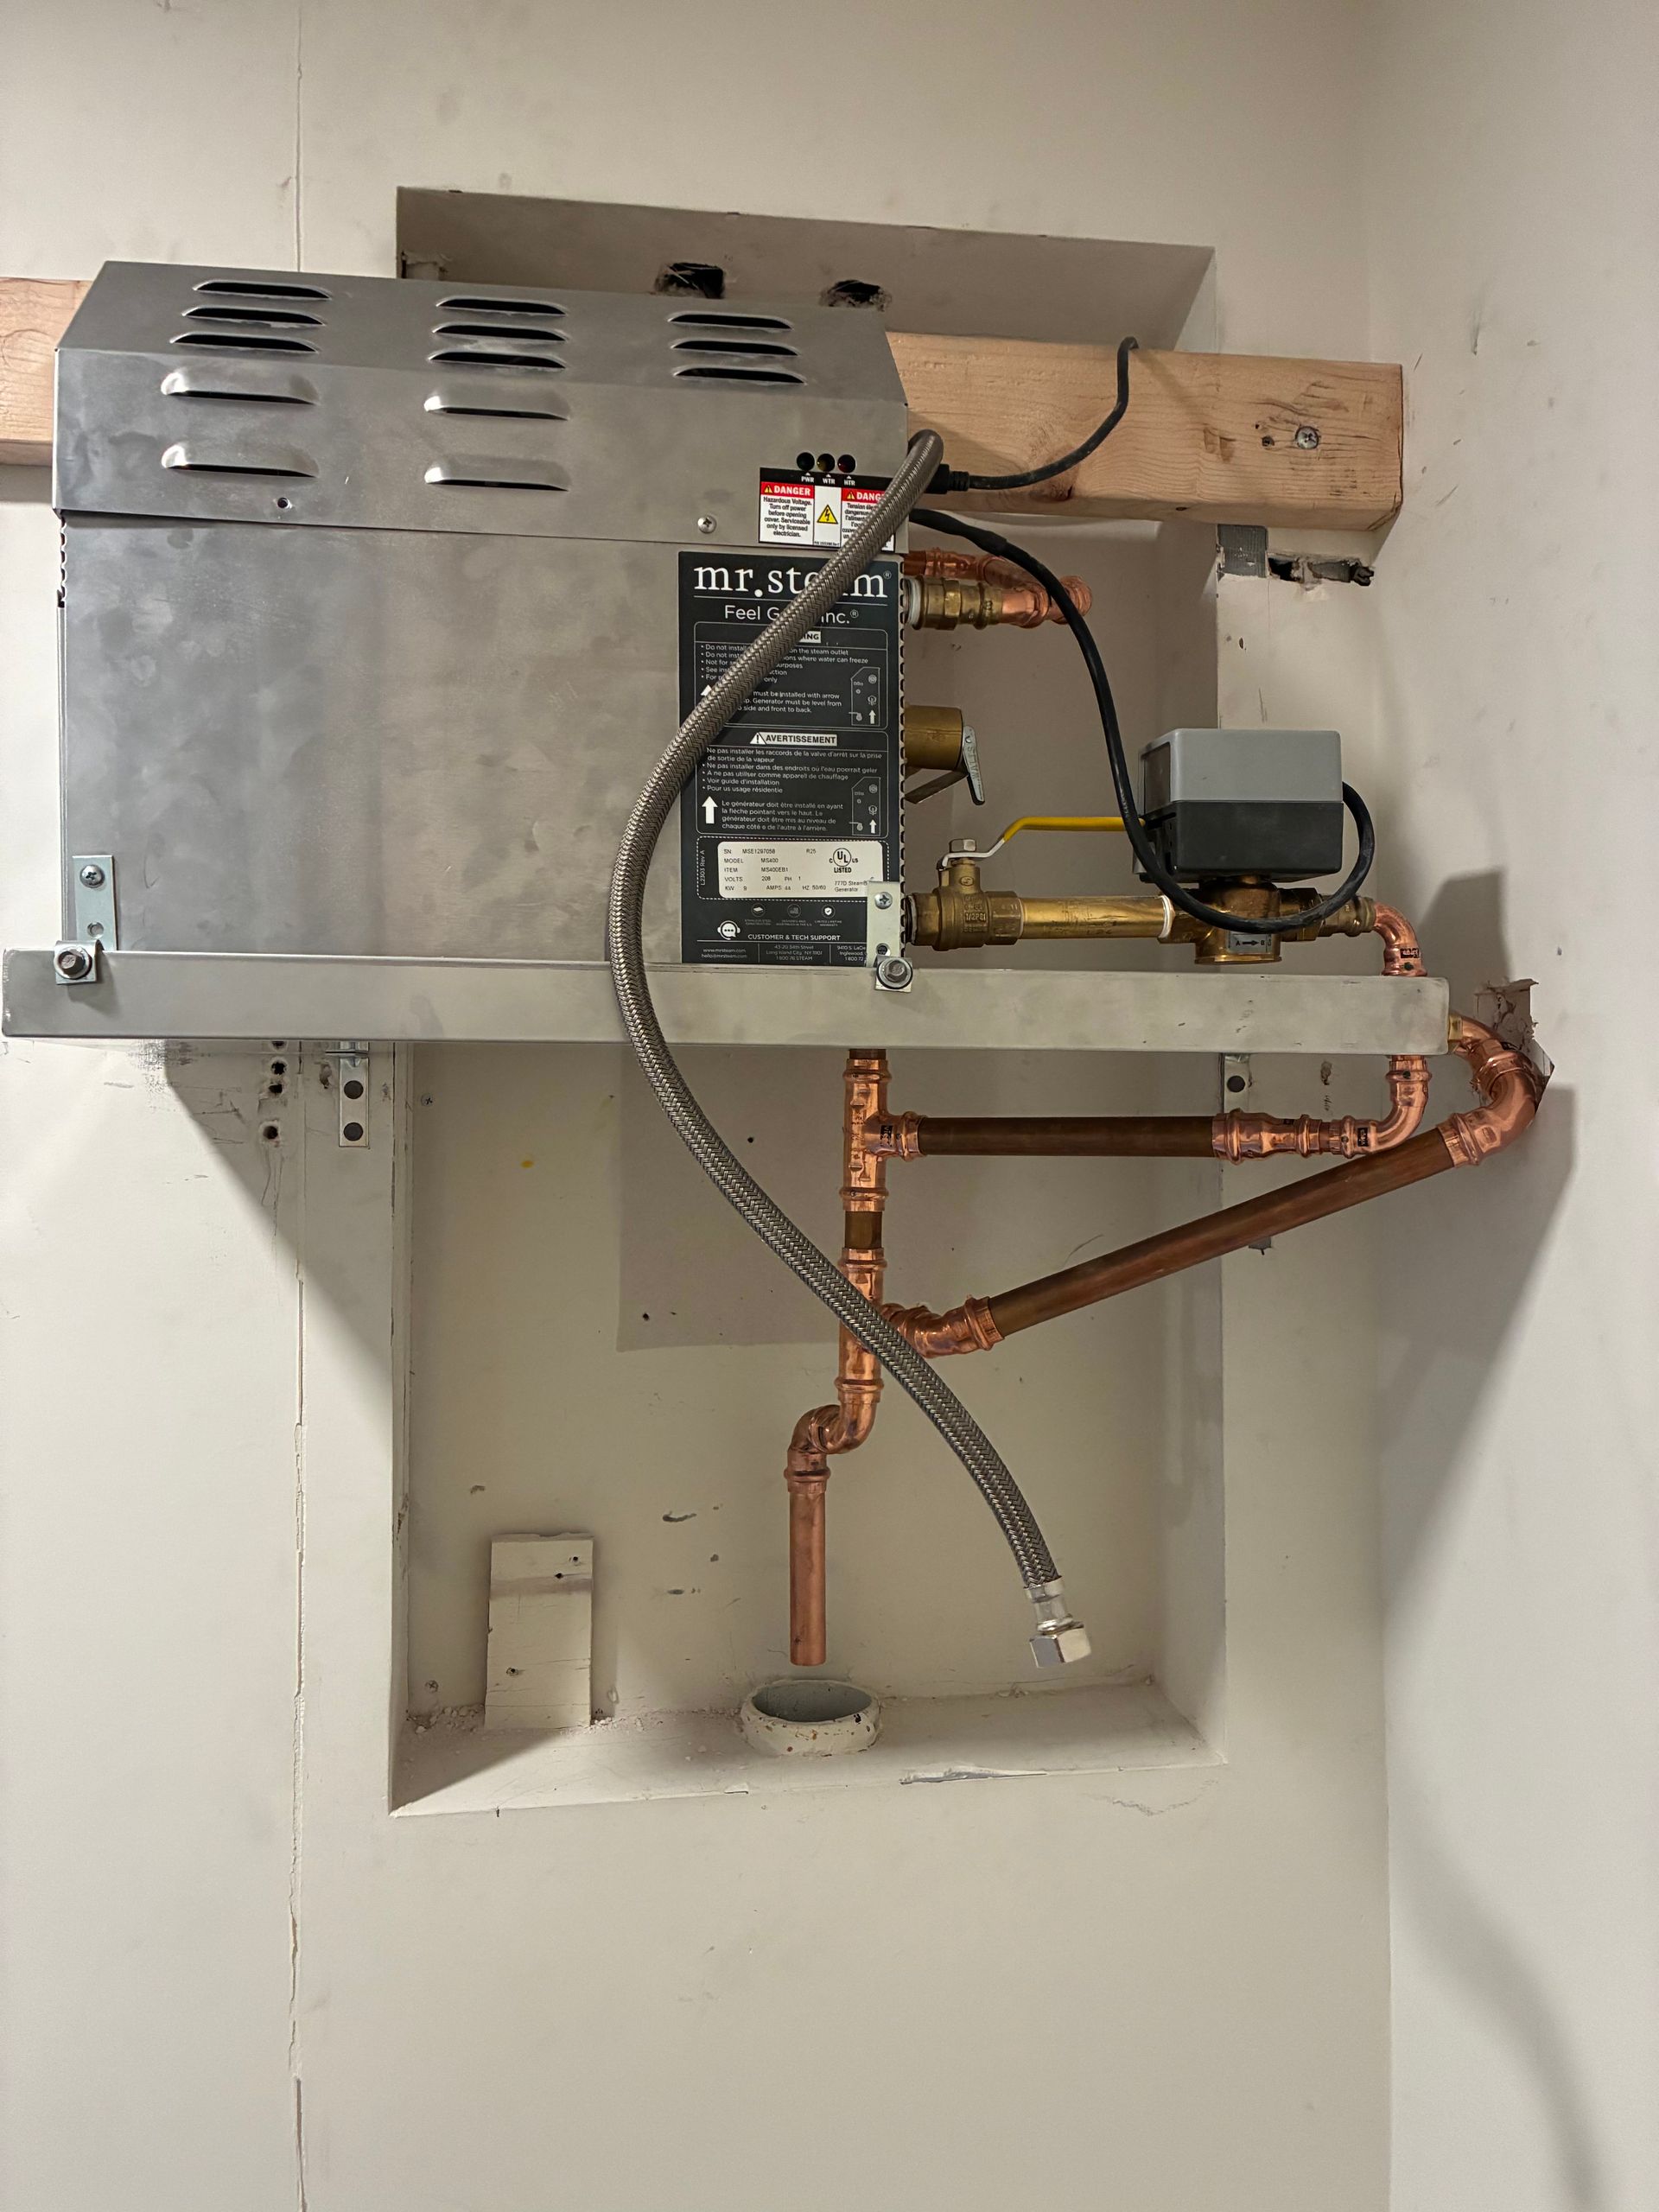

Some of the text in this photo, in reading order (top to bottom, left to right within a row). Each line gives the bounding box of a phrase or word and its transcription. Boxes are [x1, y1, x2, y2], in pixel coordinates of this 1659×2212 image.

[774, 486, 810, 496] DANGER
[857, 492, 885, 500] DANG
[694, 566, 892, 598] mr.stm®
[725, 606, 760, 620] Feel
[766, 734, 836, 744] AVERTISSEMENT
